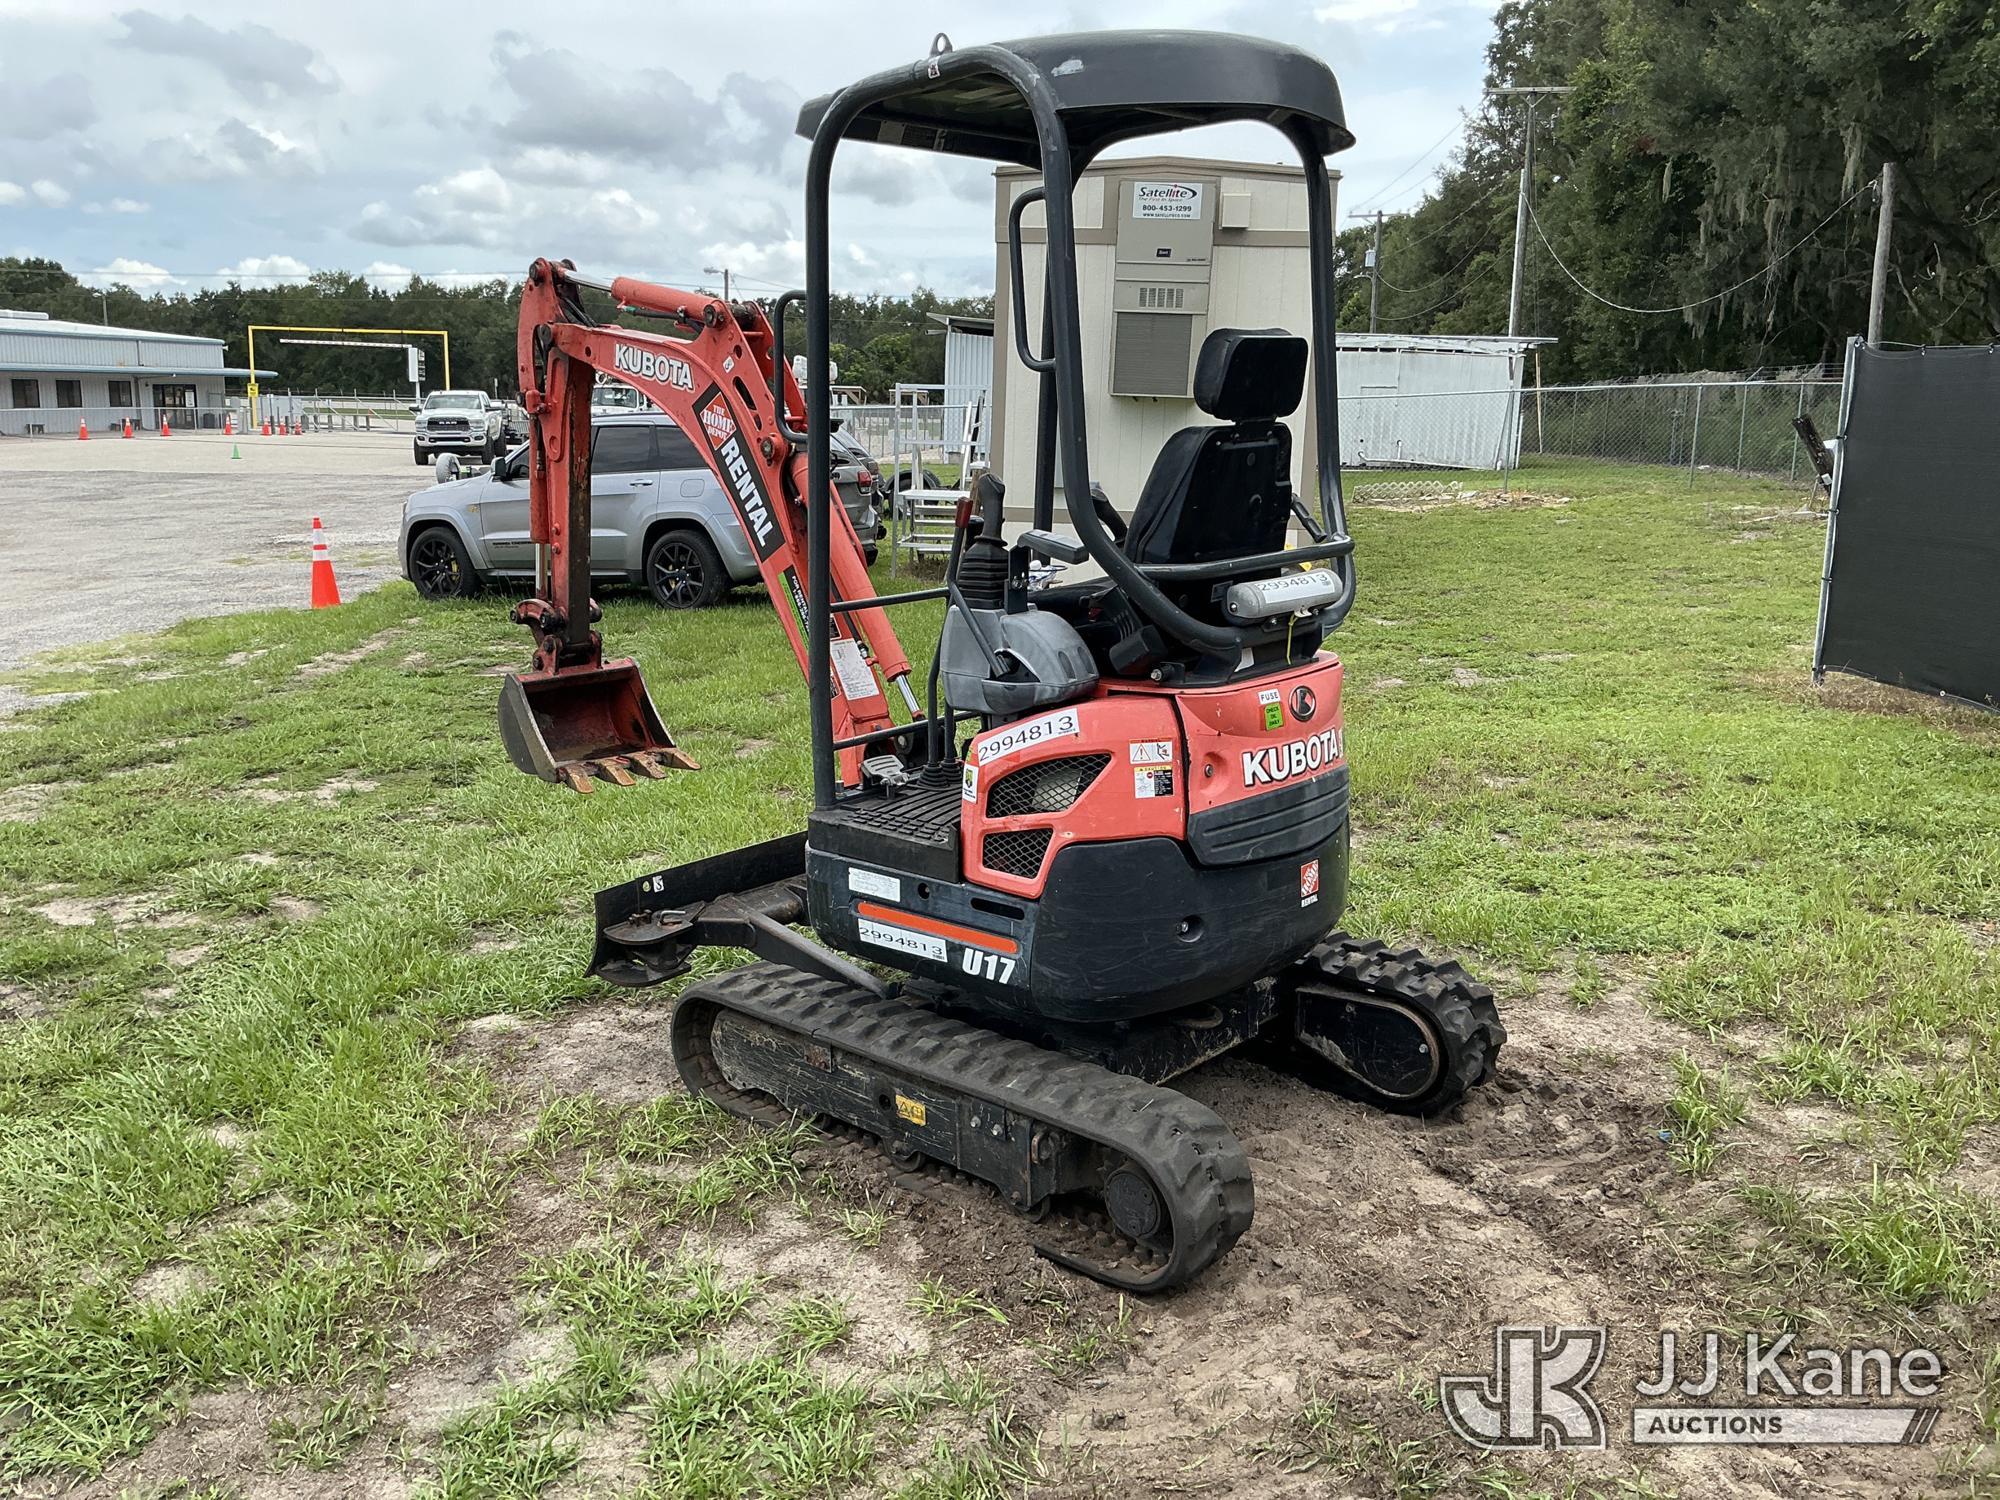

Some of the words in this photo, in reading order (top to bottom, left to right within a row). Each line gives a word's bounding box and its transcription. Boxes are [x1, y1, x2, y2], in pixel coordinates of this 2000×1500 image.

[1139, 186, 1188, 198] Satellite
[1142, 204, 1192, 212] 800-453-1299
[614, 342, 694, 391] KUBOTA
[702, 409, 734, 433] HOME
[713, 404, 725, 417] THE
[705, 425, 728, 441] DEPOT
[720, 436, 774, 548] RENTAL
[1256, 573, 1328, 591] 2994813
[1260, 691, 1279, 702] FUSE
[978, 715, 1074, 762] 2994813
[1242, 727, 1339, 787] KUBOTA
[859, 926, 943, 956] 2994813
[961, 947, 1016, 984] U17
